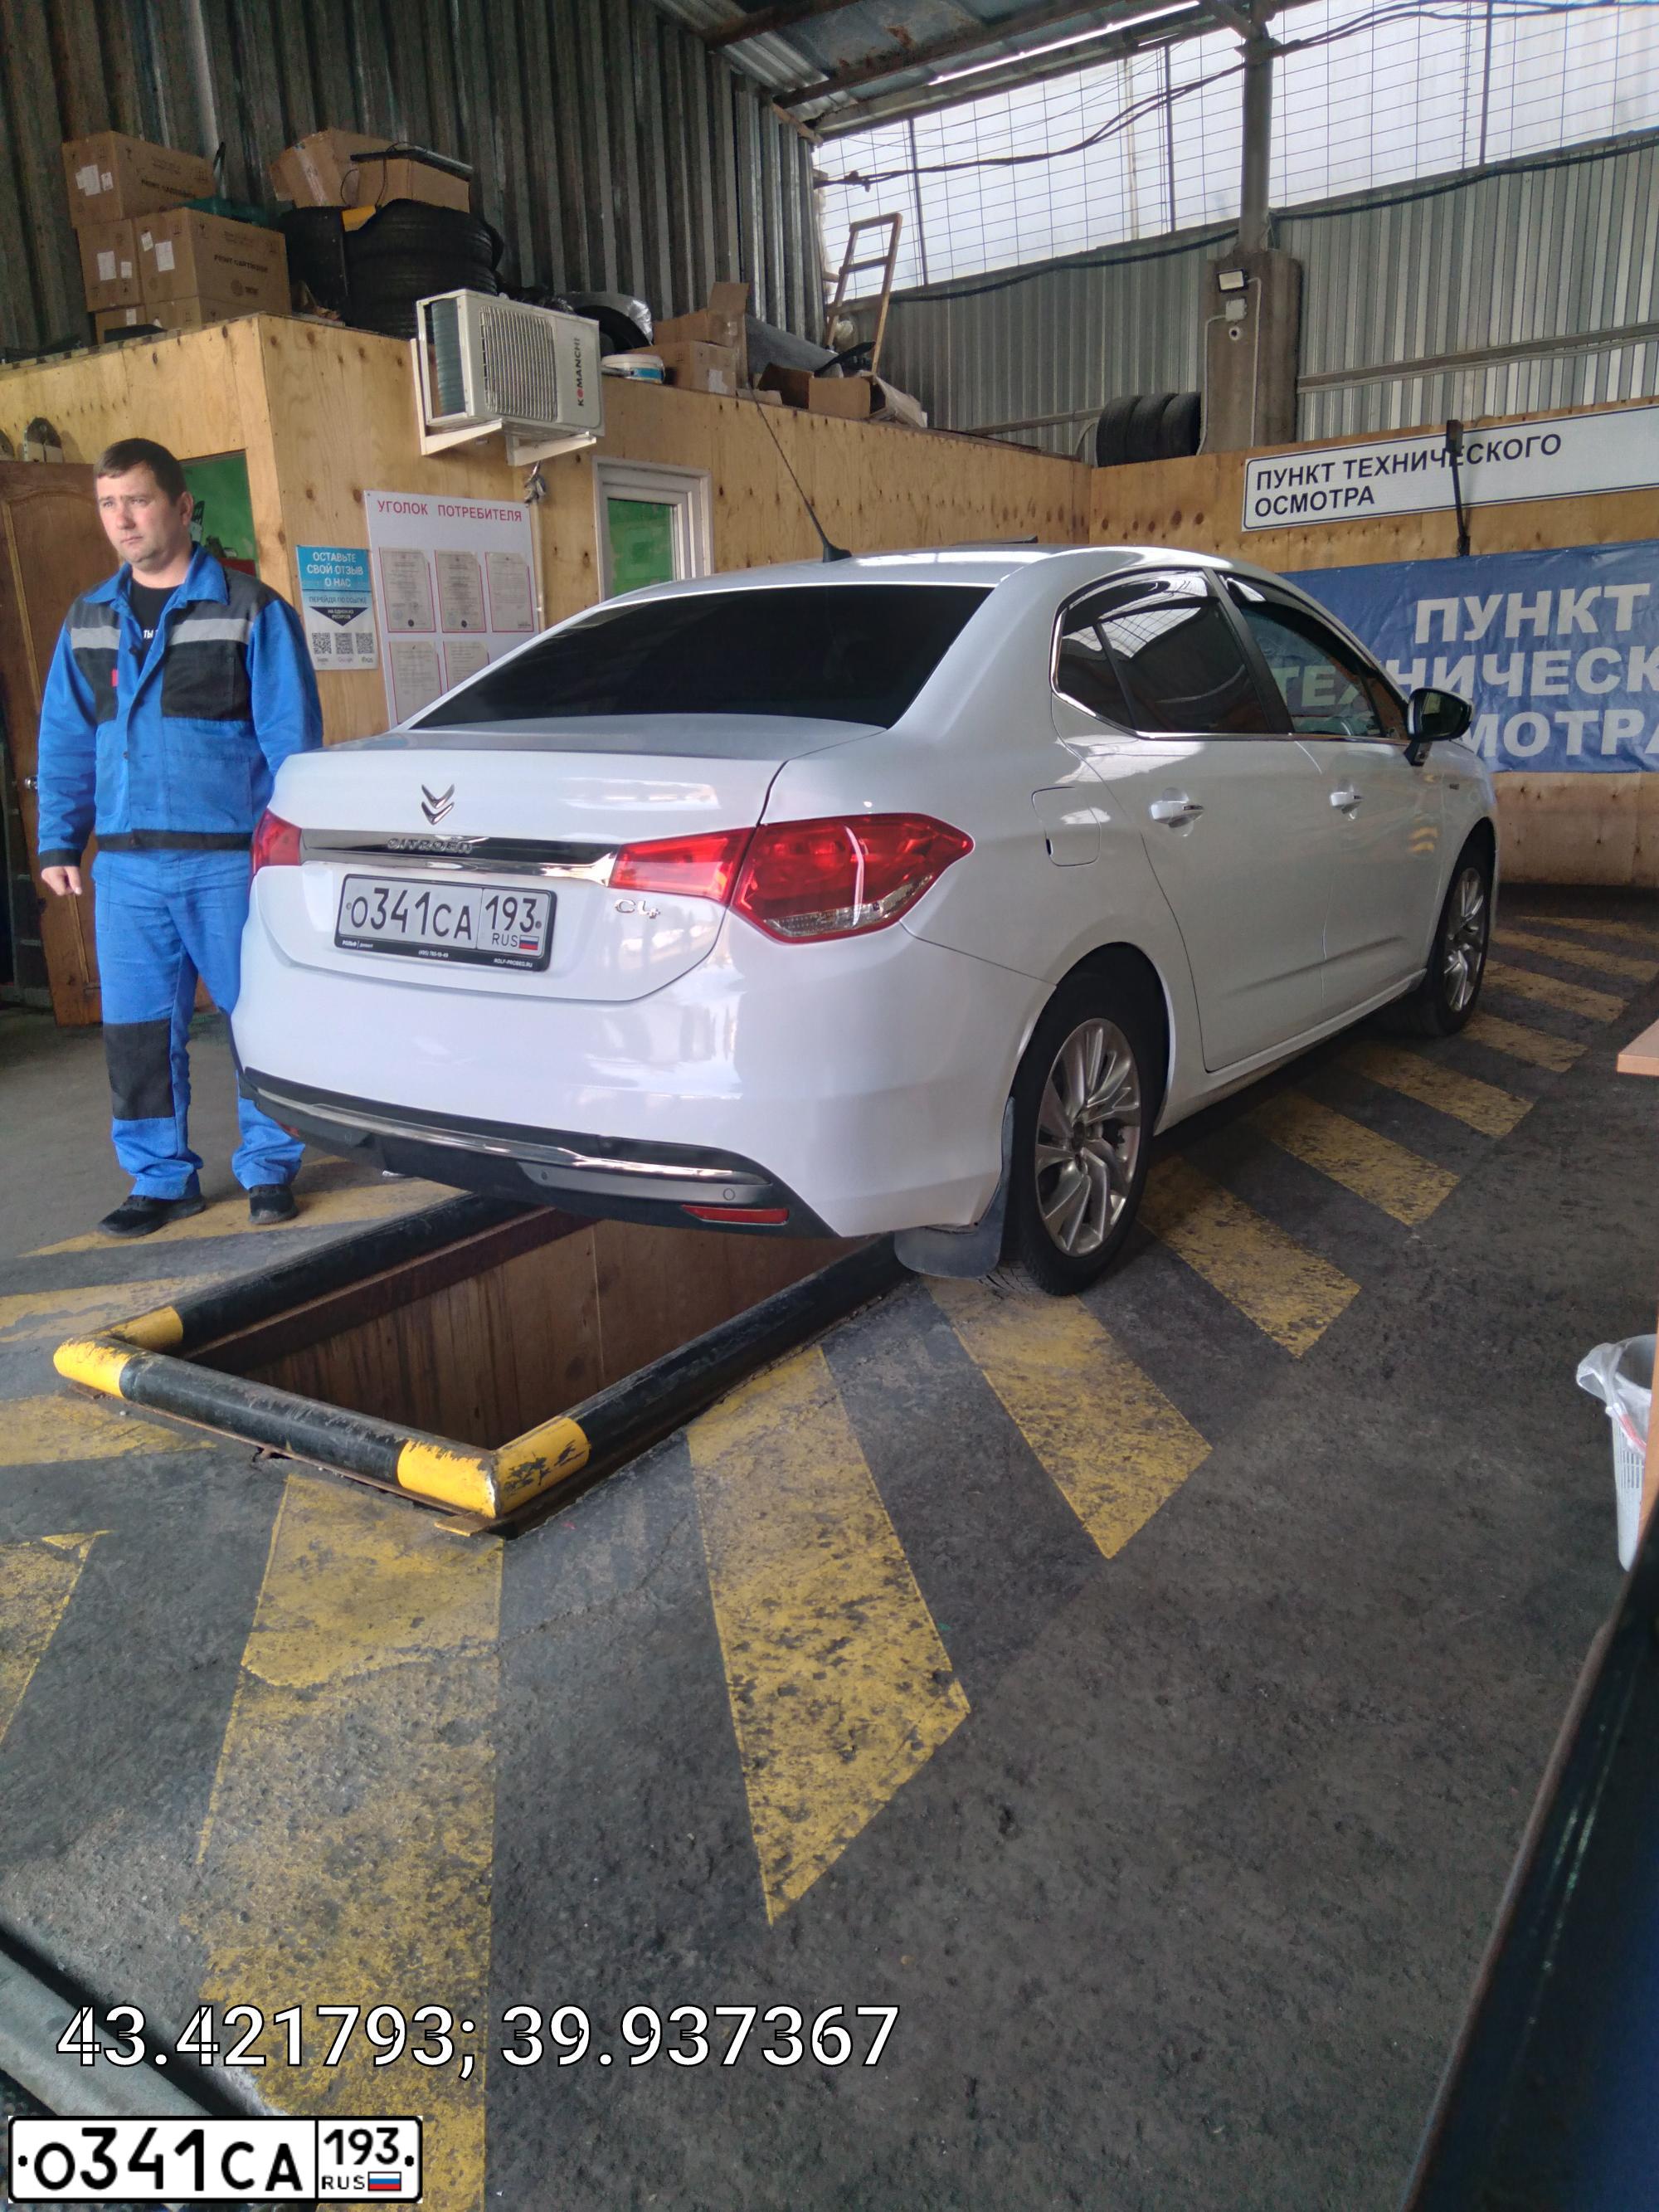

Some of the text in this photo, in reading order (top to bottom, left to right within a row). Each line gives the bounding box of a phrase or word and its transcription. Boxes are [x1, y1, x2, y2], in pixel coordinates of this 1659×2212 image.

[1257, 462, 1335, 490] ПУНКТ
[377, 500, 522, 521] УГОЛОК ПОТРЕБИТЕЛЯ
[1255, 485, 1374, 517] ОСМОТРА
[313, 552, 357, 563] ОСТАВЬТЕ
[307, 563, 363, 575] СВОЙ ОТЗЫВ
[324, 577, 351, 587] О НАС
[1415, 583, 1650, 644] ПУНКТ
[351, 887, 538, 940] О341СА 193
[492, 933, 518, 948] RUS
